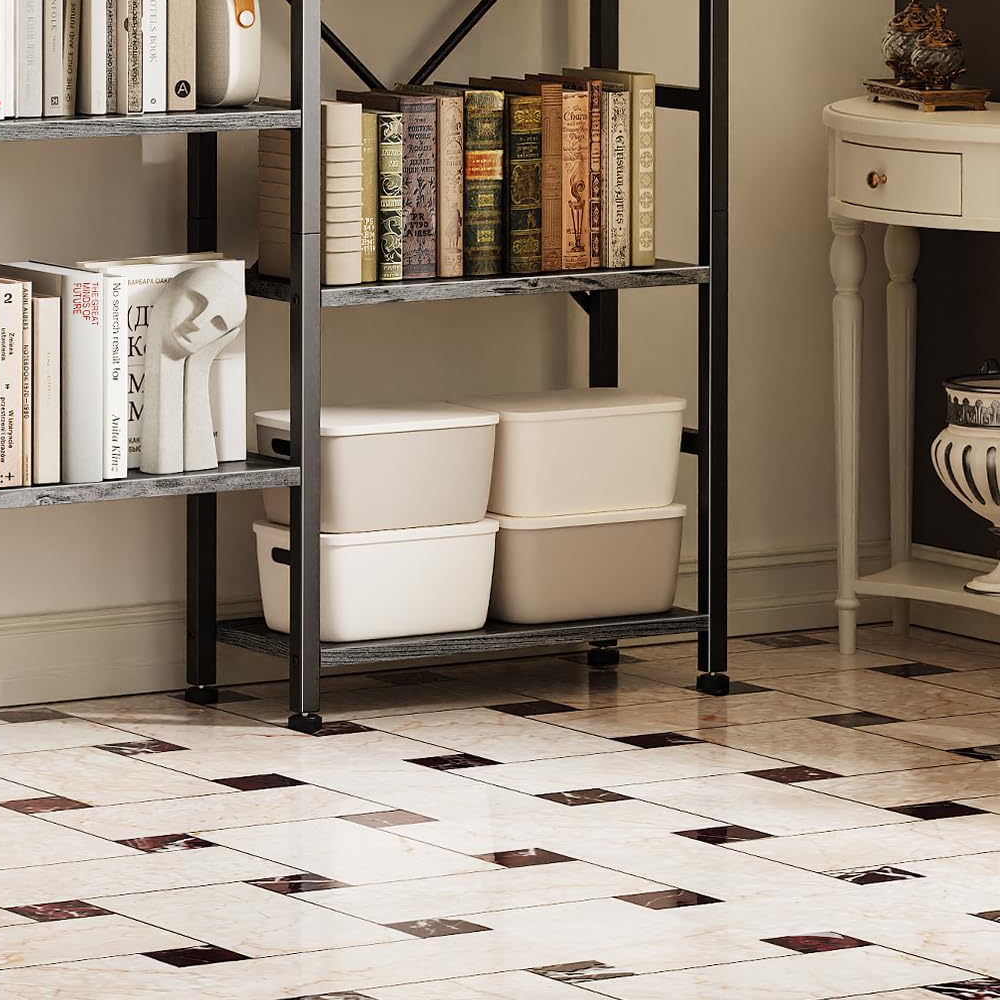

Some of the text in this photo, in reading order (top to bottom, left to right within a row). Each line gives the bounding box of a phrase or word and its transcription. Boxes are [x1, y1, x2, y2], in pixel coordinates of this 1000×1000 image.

[150, 36, 158, 64] BOOK
[4, 292, 12, 304] 2
[73, 282, 82, 314] FUTURE
[82, 282, 90, 320] MINDS OF
[112, 283, 121, 297] No
[91, 298, 99, 326] GREAT
[112, 300, 121, 334] search
[112, 336, 121, 364] result
[112, 414, 120, 442] Anita
